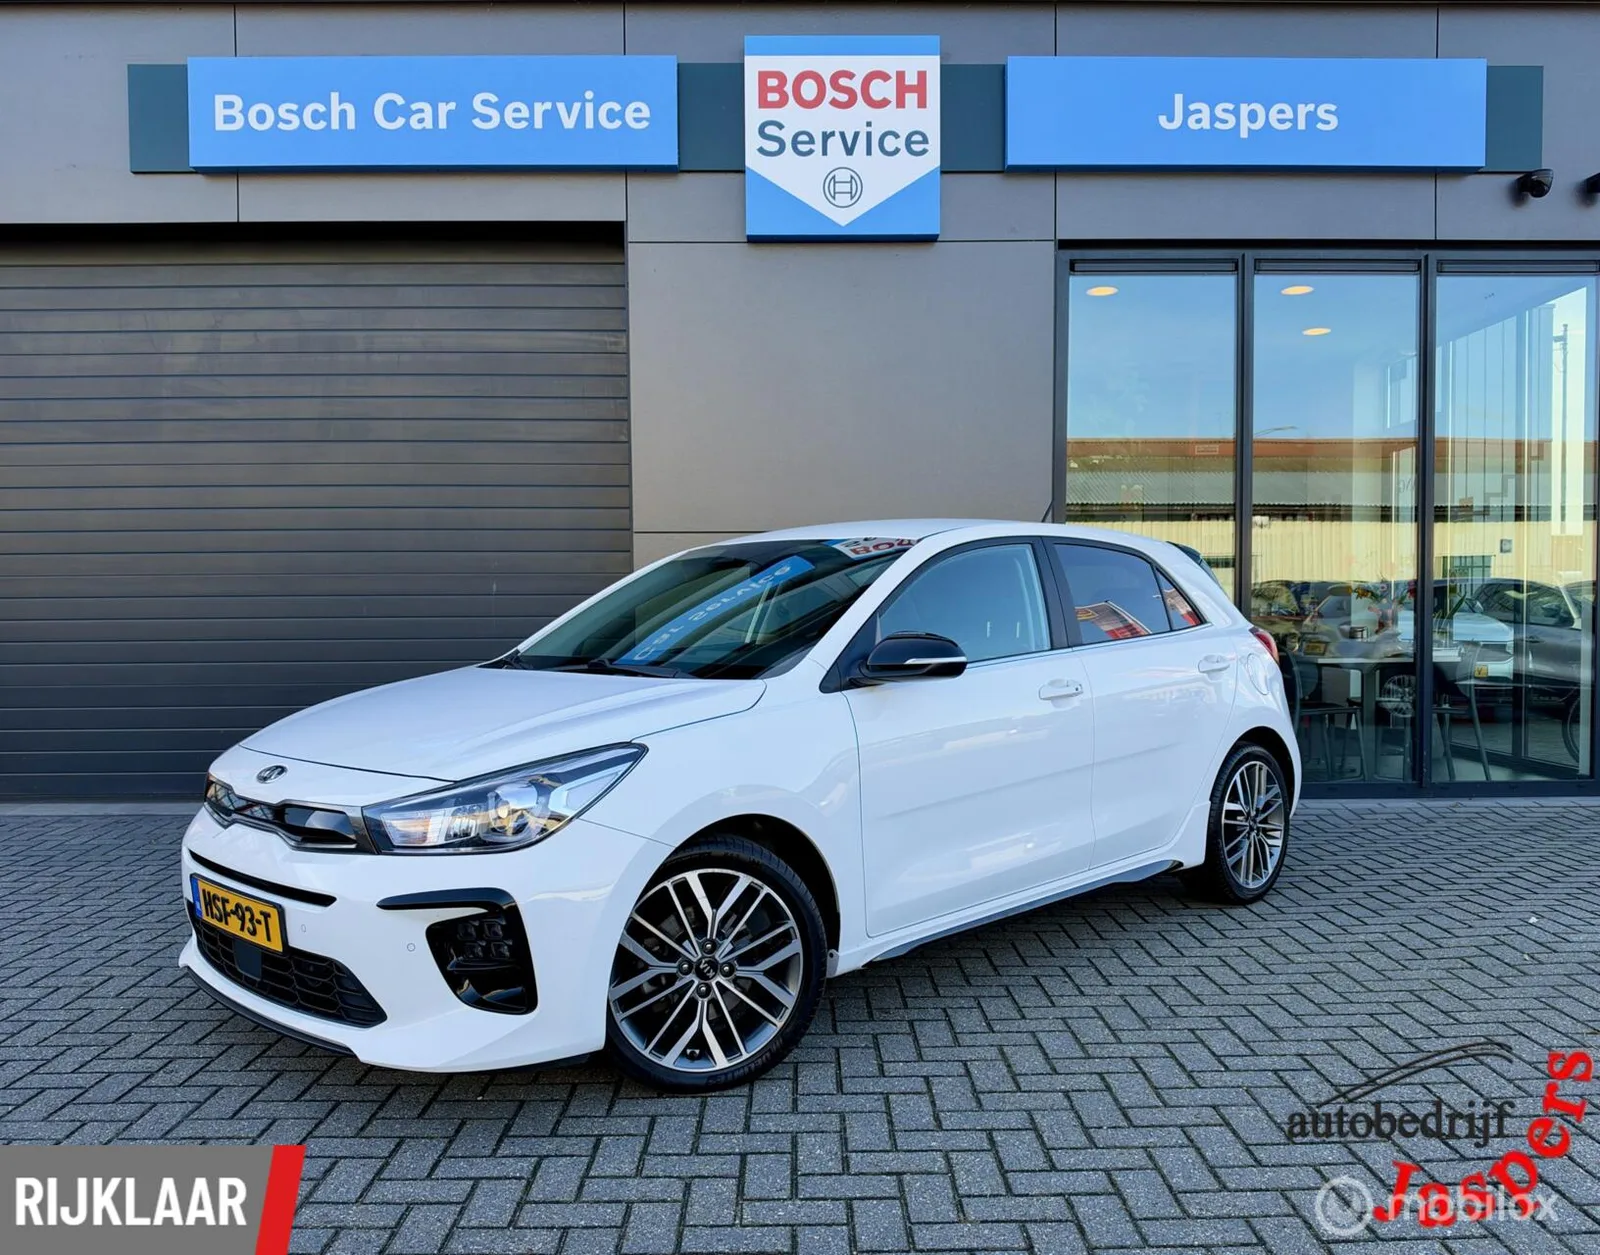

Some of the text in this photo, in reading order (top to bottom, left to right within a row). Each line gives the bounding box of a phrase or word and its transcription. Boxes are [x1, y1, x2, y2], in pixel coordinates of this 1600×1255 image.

[757, 70, 928, 109] BOSCH
[214, 91, 651, 131] Bosch Car Service
[1158, 94, 1339, 138] Jaspers
[756, 120, 930, 157] Service
[202, 888, 272, 942] HSF-93-T
